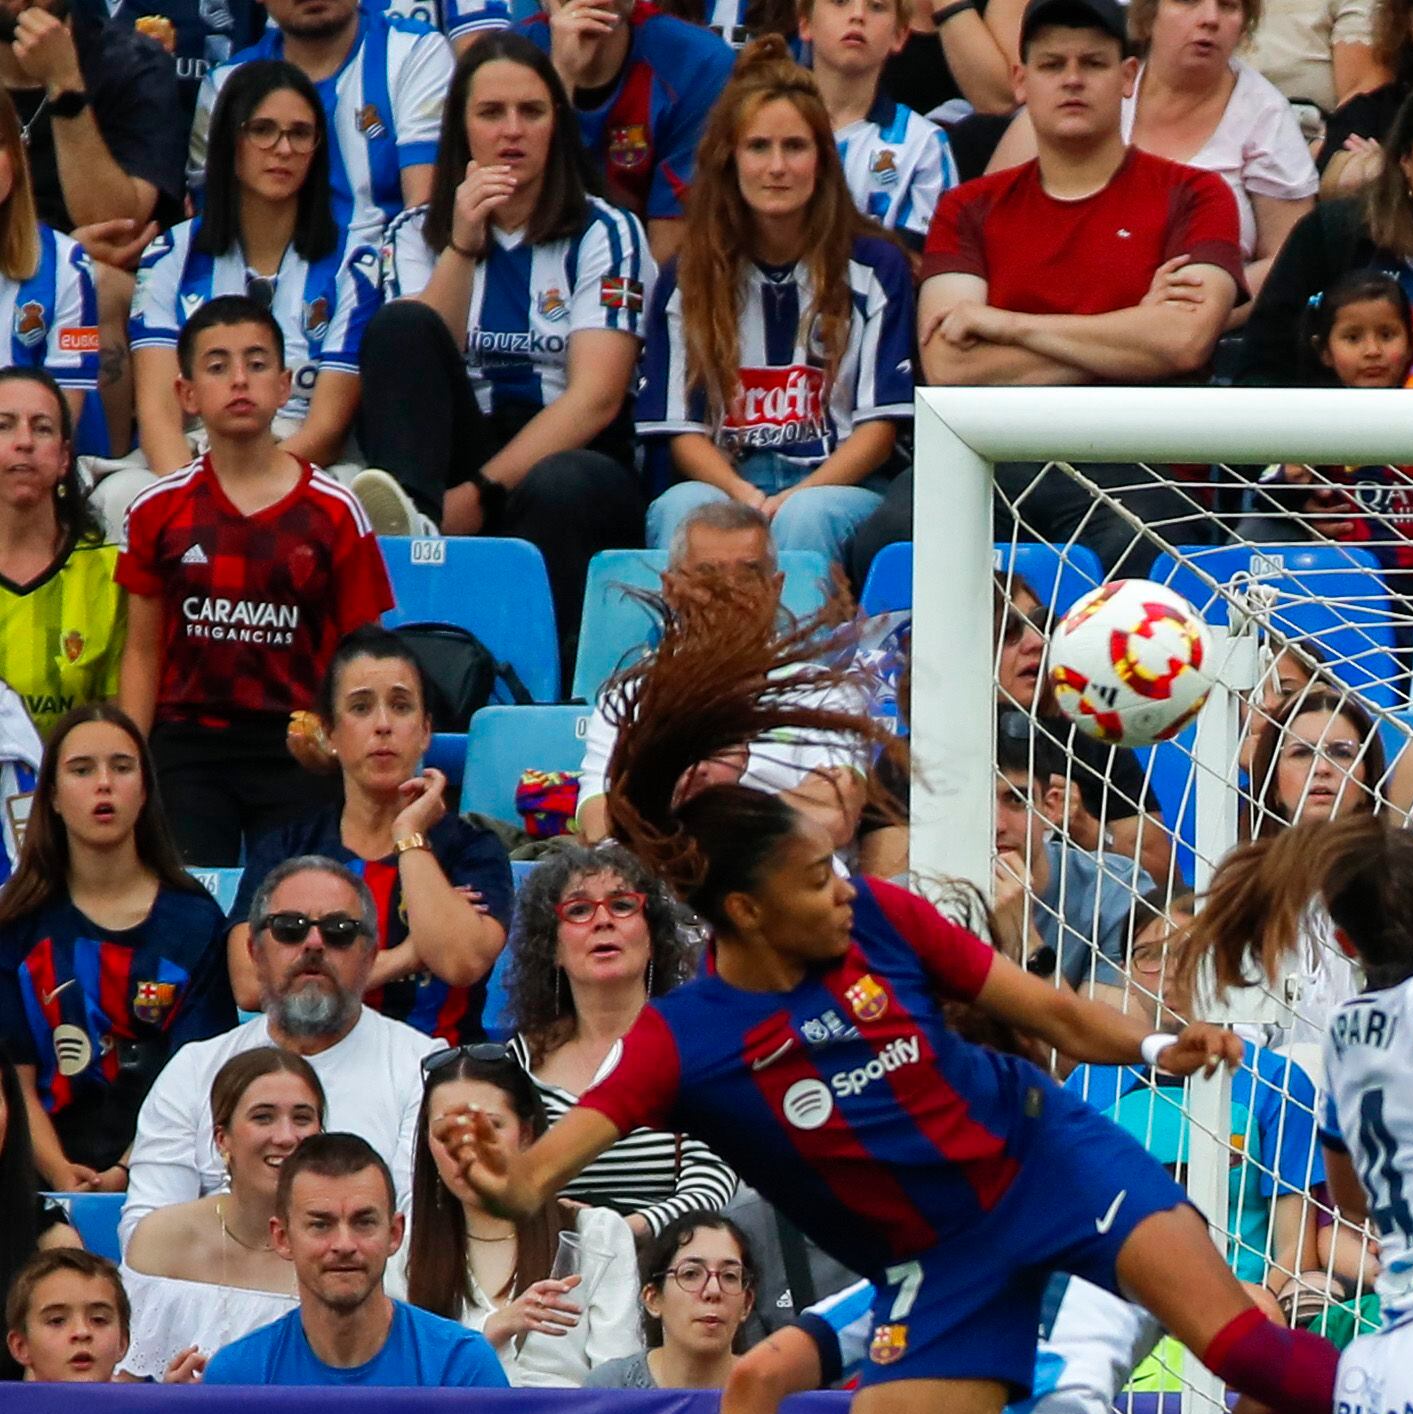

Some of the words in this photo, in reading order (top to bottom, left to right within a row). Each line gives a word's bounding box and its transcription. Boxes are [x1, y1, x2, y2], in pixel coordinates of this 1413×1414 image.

[413, 541, 442, 561] 036
[183, 597, 298, 628] CARAVAN
[186, 624, 294, 644] FRIGANCIAS
[831, 1035, 920, 1097] Spotify
[885, 1260, 925, 1321] 7
